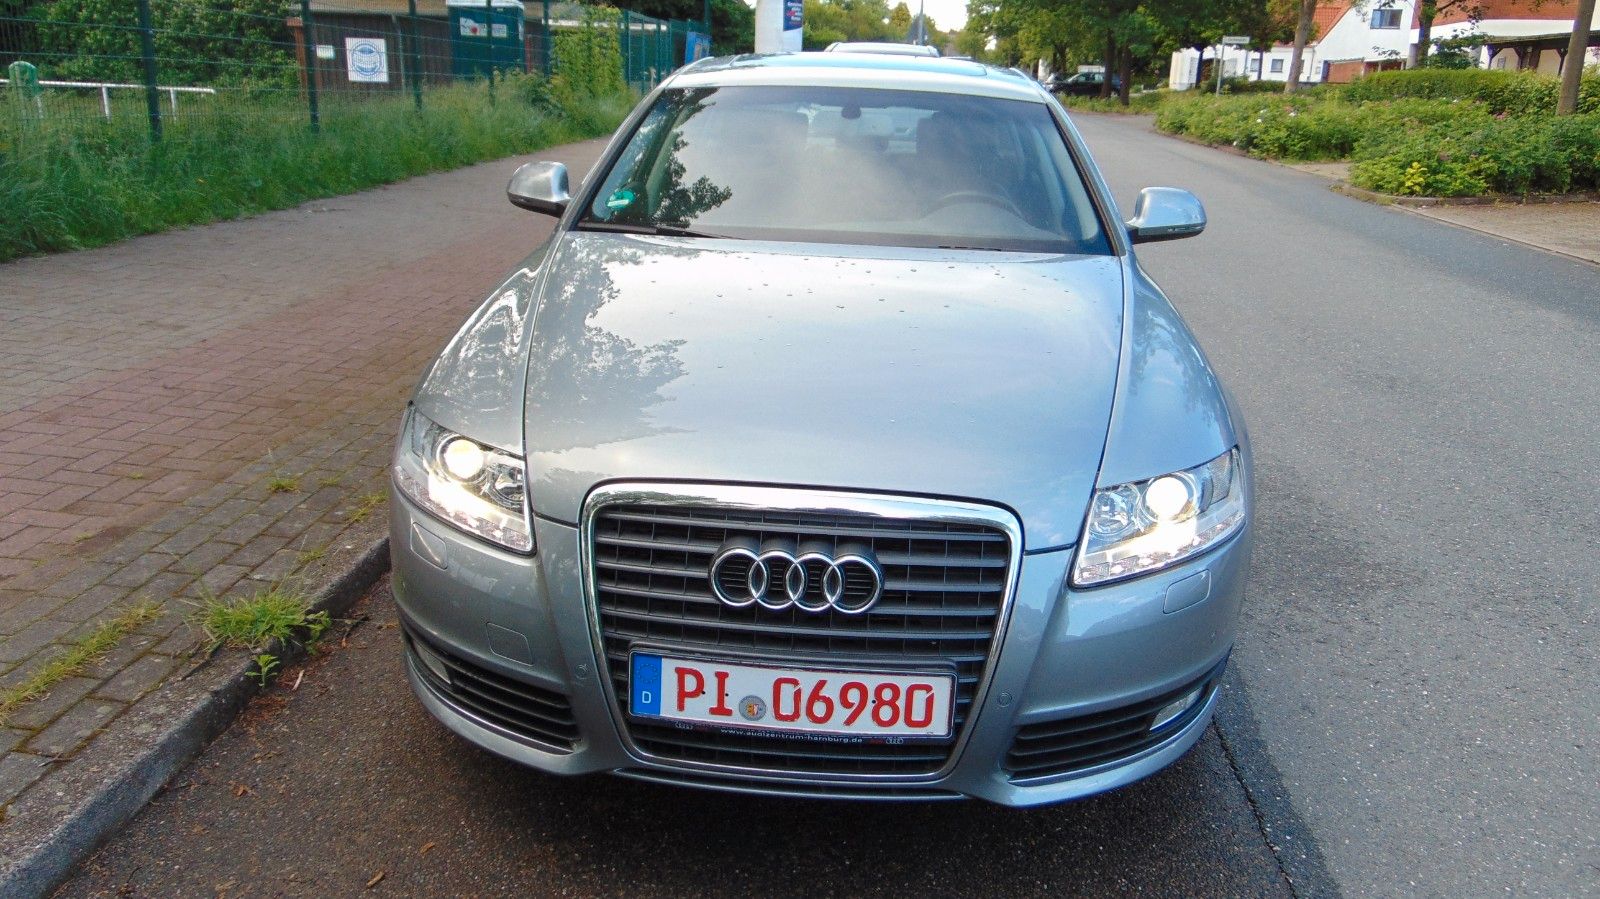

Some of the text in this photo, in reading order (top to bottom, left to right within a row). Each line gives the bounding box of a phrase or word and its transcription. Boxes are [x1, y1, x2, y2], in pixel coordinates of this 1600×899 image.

[641, 691, 652, 704] D
[674, 666, 935, 729] PI 06980
